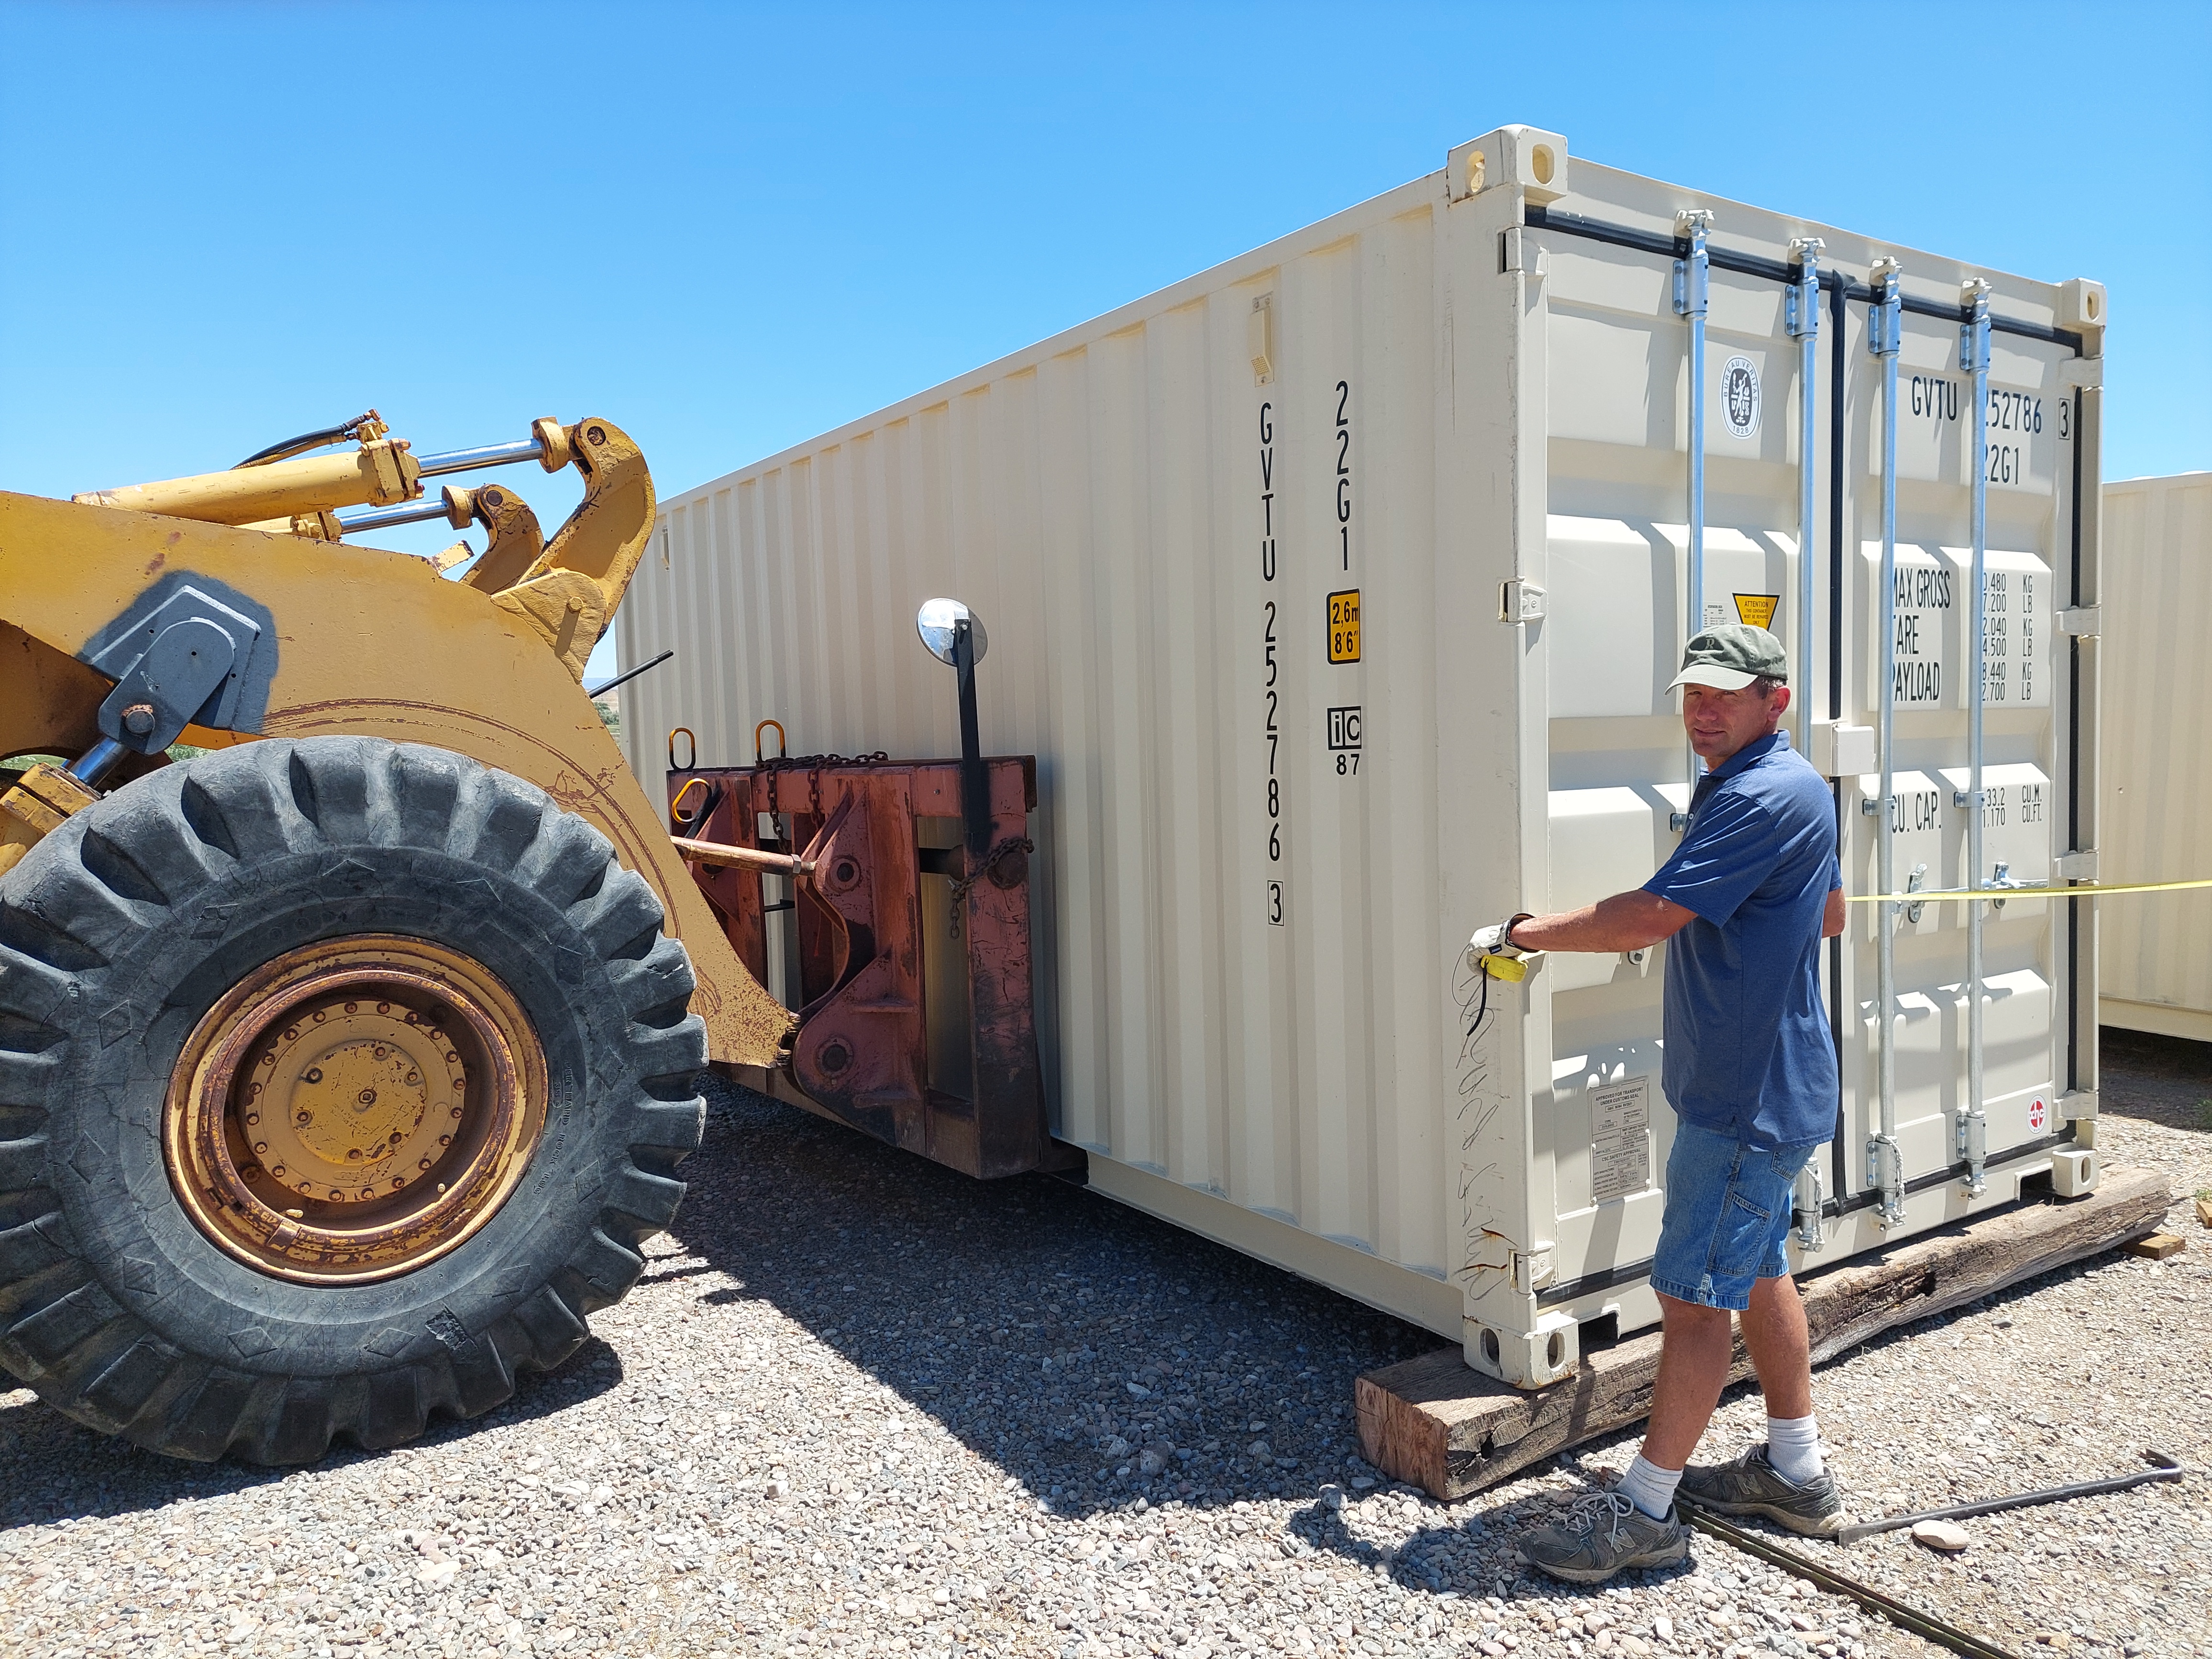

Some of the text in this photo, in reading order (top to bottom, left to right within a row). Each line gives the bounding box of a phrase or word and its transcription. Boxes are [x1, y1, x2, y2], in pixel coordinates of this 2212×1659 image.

[1724, 360, 1757, 402] BUREAU VERITAS
[1912, 376, 2068, 437] GVTU 52786 3
[1733, 425, 1749, 434] 1828
[1335, 380, 1350, 571] 22G1
[1985, 443, 2019, 485] 2G1
[1916, 568, 1950, 608] GROSS
[1983, 572, 2006, 592] 0,480
[2023, 574, 2033, 593] KG
[1983, 593, 2033, 613] 7,200 LB
[1332, 600, 1359, 628] 2,6m
[1893, 614, 1919, 654] ARE
[2023, 618, 2033, 637] KG
[2023, 638, 2033, 657] LB
[1260, 402, 1282, 923] GVTU 252786 3
[1892, 661, 2032, 702] AYLOAD 8,440 KG
[1982, 681, 2032, 702] 2,700 LB
[1336, 753, 1360, 776] 87
[1915, 791, 1942, 831] CAP.
[1987, 787, 2005, 807] 33.2
[2022, 784, 2042, 803] CU.M.
[2022, 803, 2042, 823] CU.FT.
[562, 1091, 573, 1126] HARD
[1595, 1093, 1615, 1101] APPROVED
[1623, 1086, 1643, 1095] TRANSPORT
[549, 1133, 566, 1165] ROCK
[1623, 1148, 1641, 1156] APPROVAL
[533, 1172, 550, 1195] LUG
